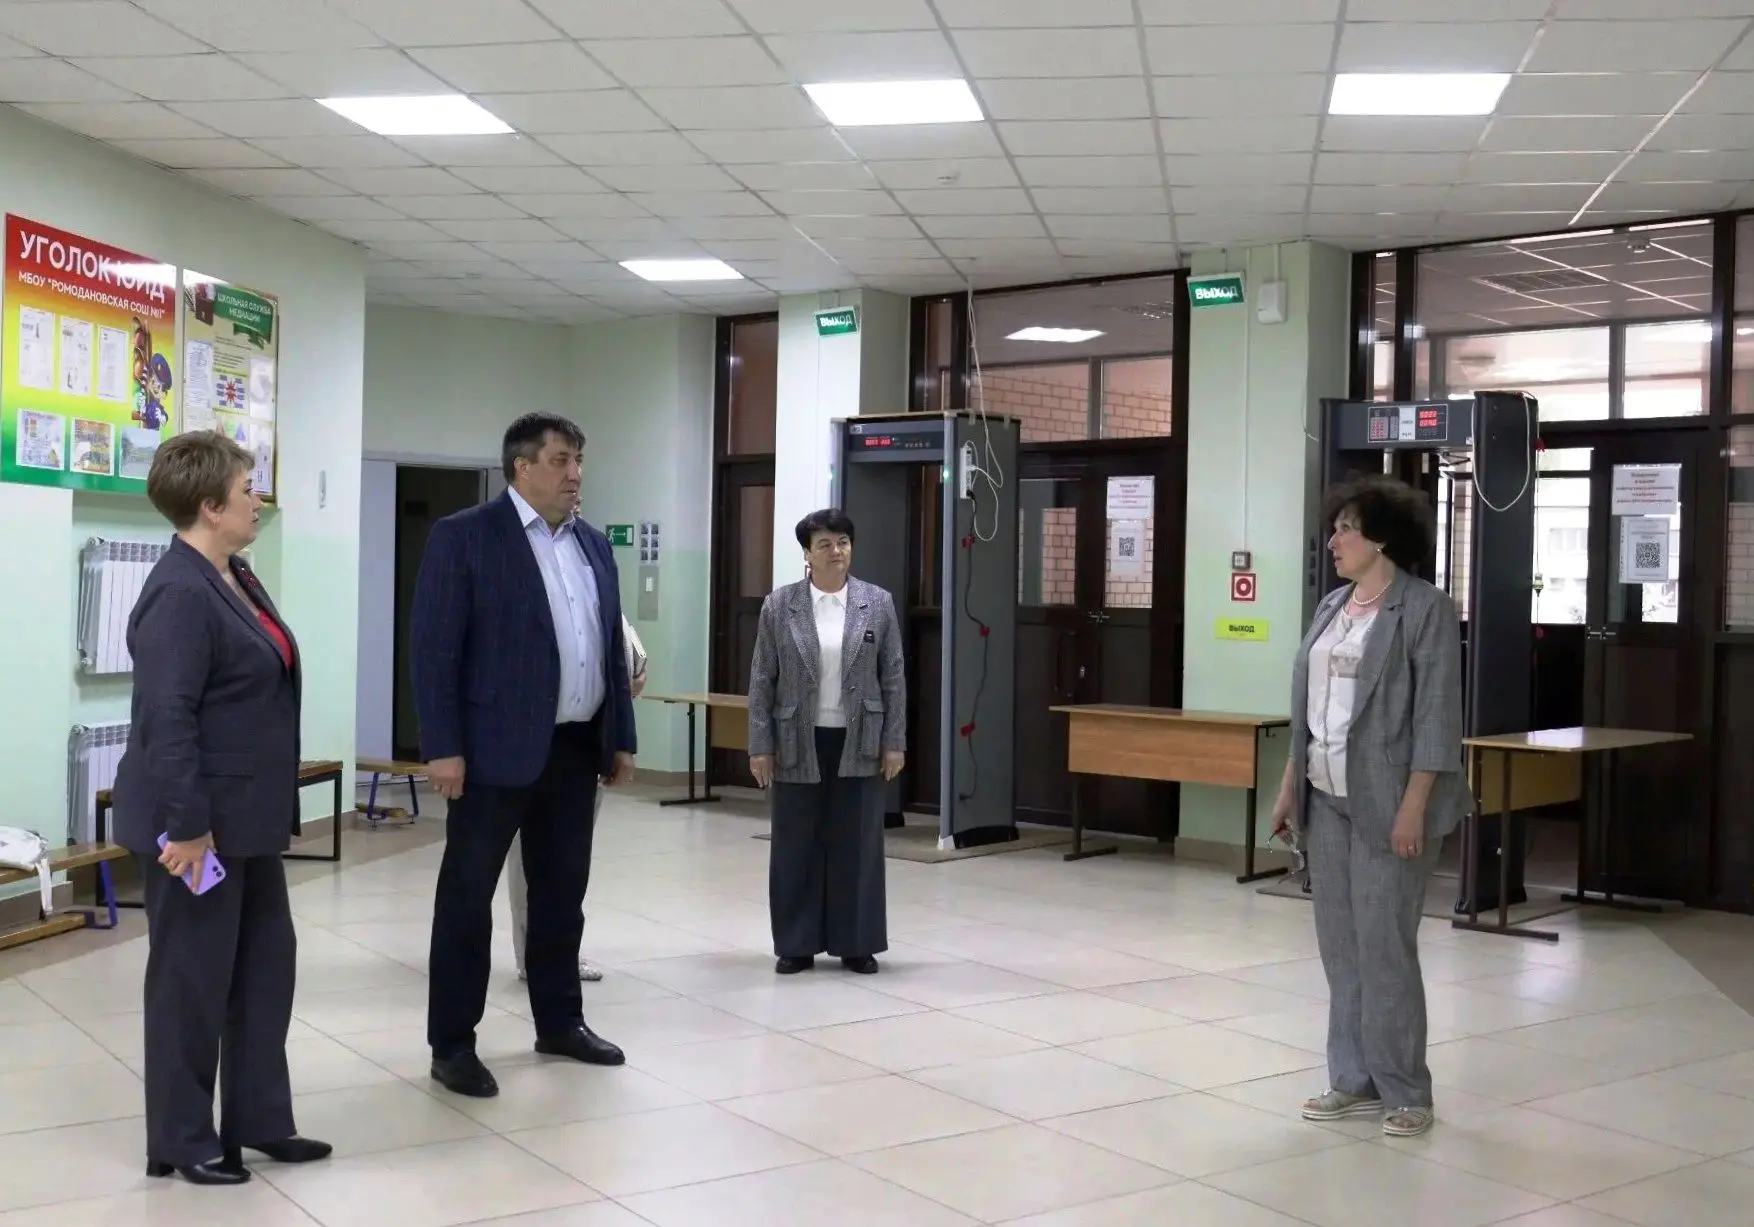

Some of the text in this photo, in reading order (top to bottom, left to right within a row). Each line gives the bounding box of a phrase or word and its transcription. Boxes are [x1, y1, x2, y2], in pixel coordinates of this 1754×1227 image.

[20, 230, 111, 284] УГОЛОК
[18, 270, 46, 287] МБОУ
[47, 279, 129, 310] "РОМОДАНОВСКАЯ
[130, 301, 149, 315] СОШ
[1195, 285, 1238, 300] ВЫХОД
[217, 292, 271, 315] ШКОЛЬНАЯ СЛУЖБА
[820, 314, 852, 327] ВЫХОД
[1228, 624, 1255, 634] ВЫХОД
